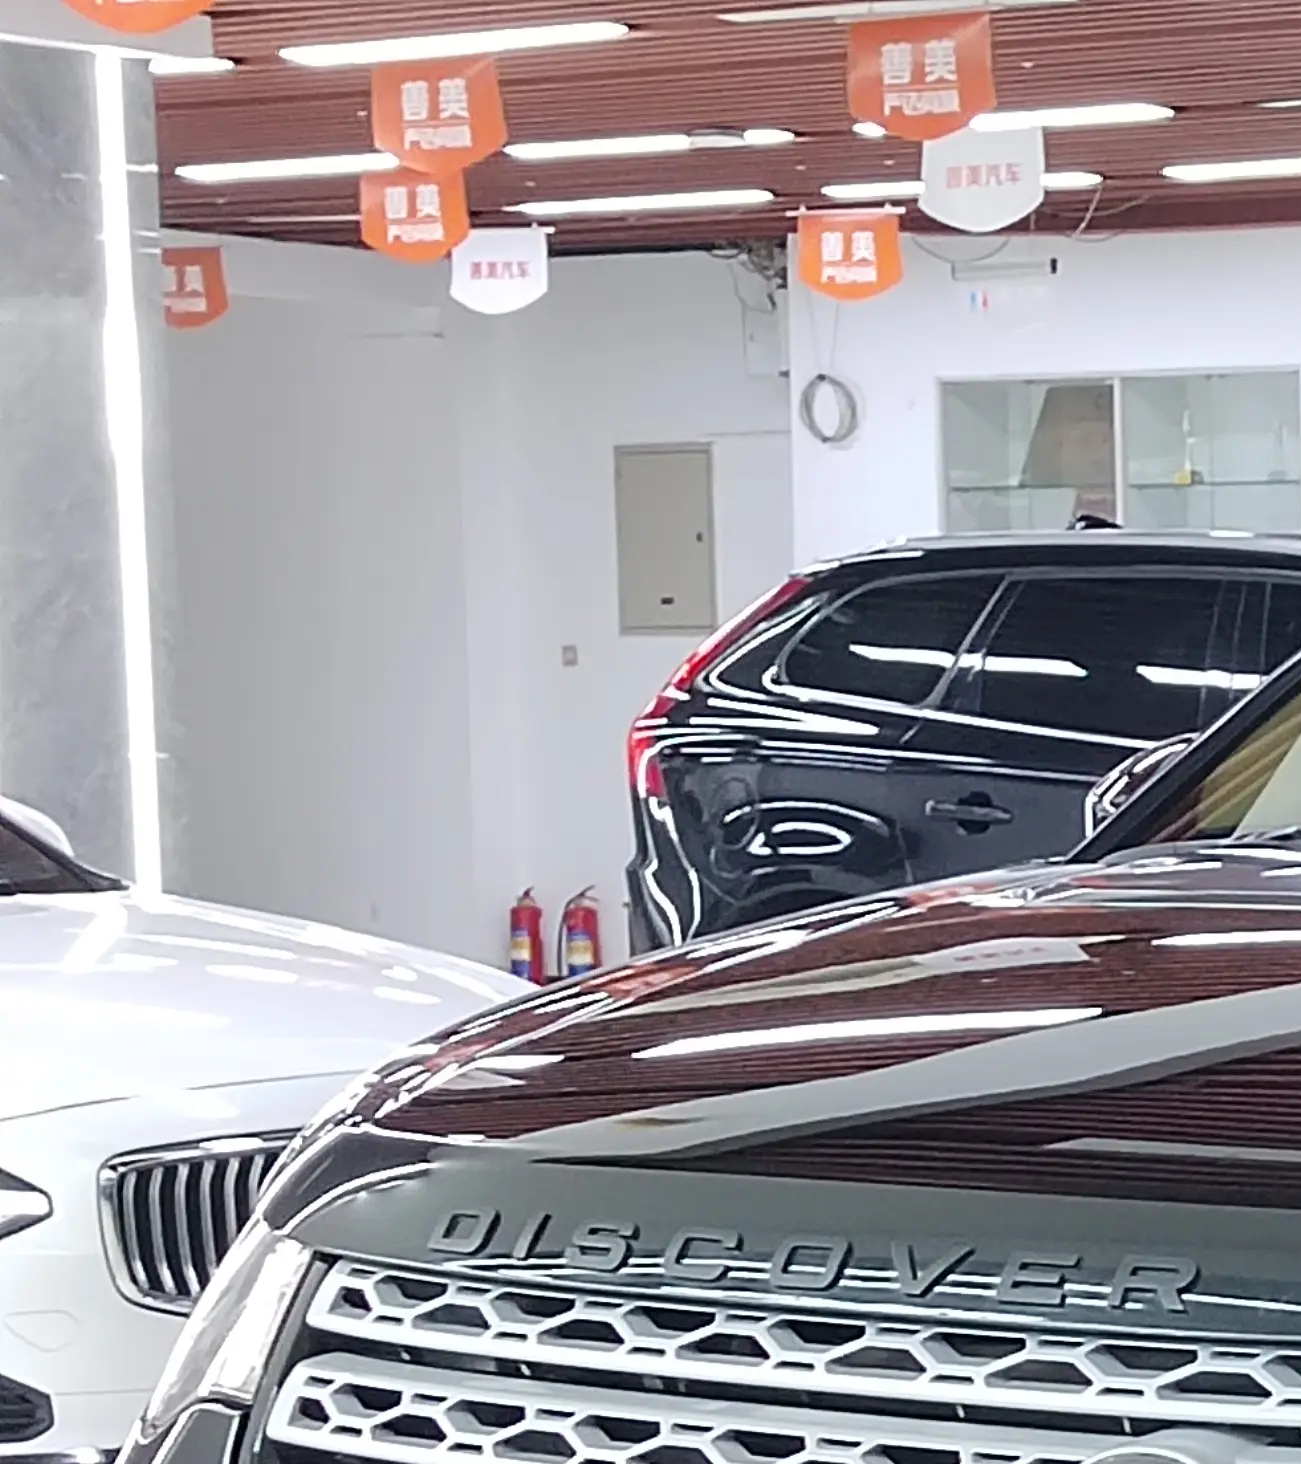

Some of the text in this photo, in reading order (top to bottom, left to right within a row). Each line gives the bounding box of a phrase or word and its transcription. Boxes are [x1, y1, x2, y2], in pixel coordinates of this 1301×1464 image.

[881, 38, 957, 85] 善美
[401, 78, 470, 120] 善美
[427, 1206, 1202, 1315] DISCOVER
